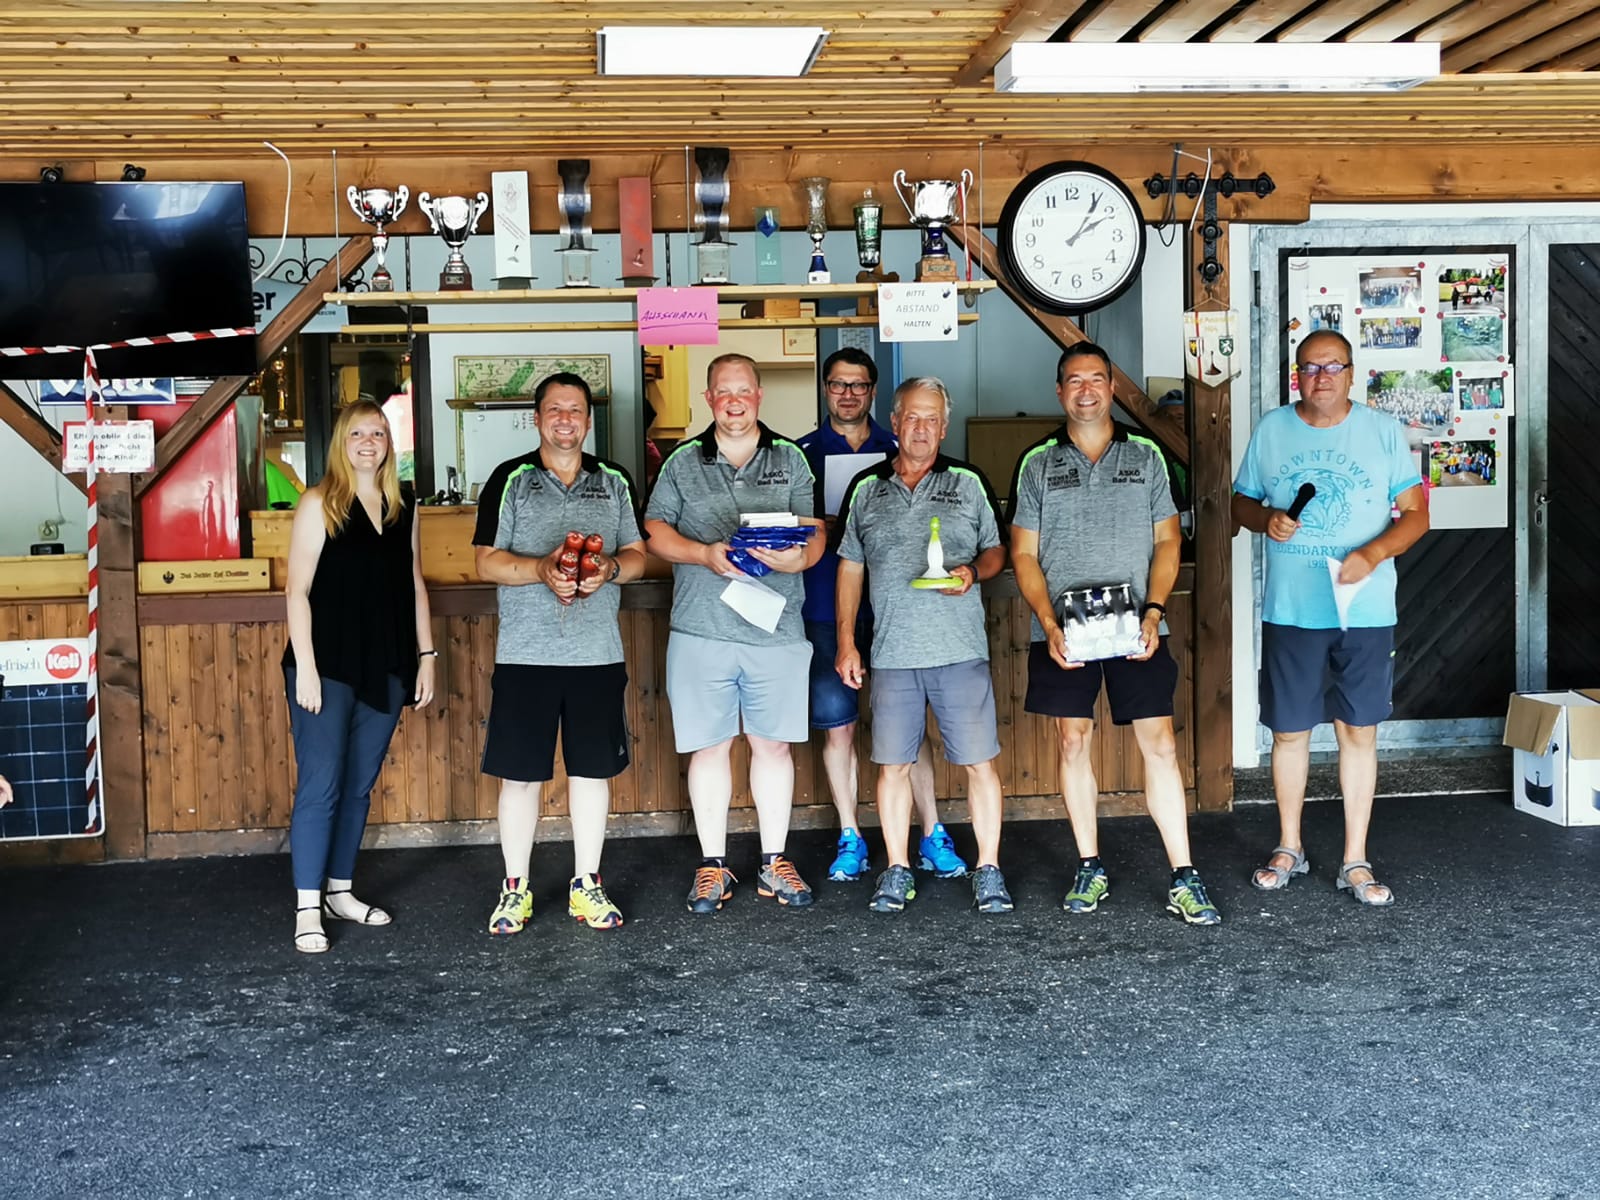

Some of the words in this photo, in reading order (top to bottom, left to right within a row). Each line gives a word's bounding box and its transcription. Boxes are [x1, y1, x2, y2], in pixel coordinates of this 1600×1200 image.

[1065, 186, 1080, 201] 12
[1046, 195, 1056, 209] 11
[1103, 205, 1116, 220] 2
[1031, 214, 1044, 228] 10
[1025, 233, 1036, 248] 9
[1112, 229, 1123, 243] 3
[1033, 255, 1045, 270] 8
[1105, 249, 1117, 264] 4
[1051, 271, 1062, 285] 7
[1071, 274, 1082, 289] 6
[1091, 267, 1103, 282] 5
[905, 290, 926, 298] BITTE
[895, 304, 940, 313] ABSTAND
[1271, 449, 1374, 490] DOWNTOWN
